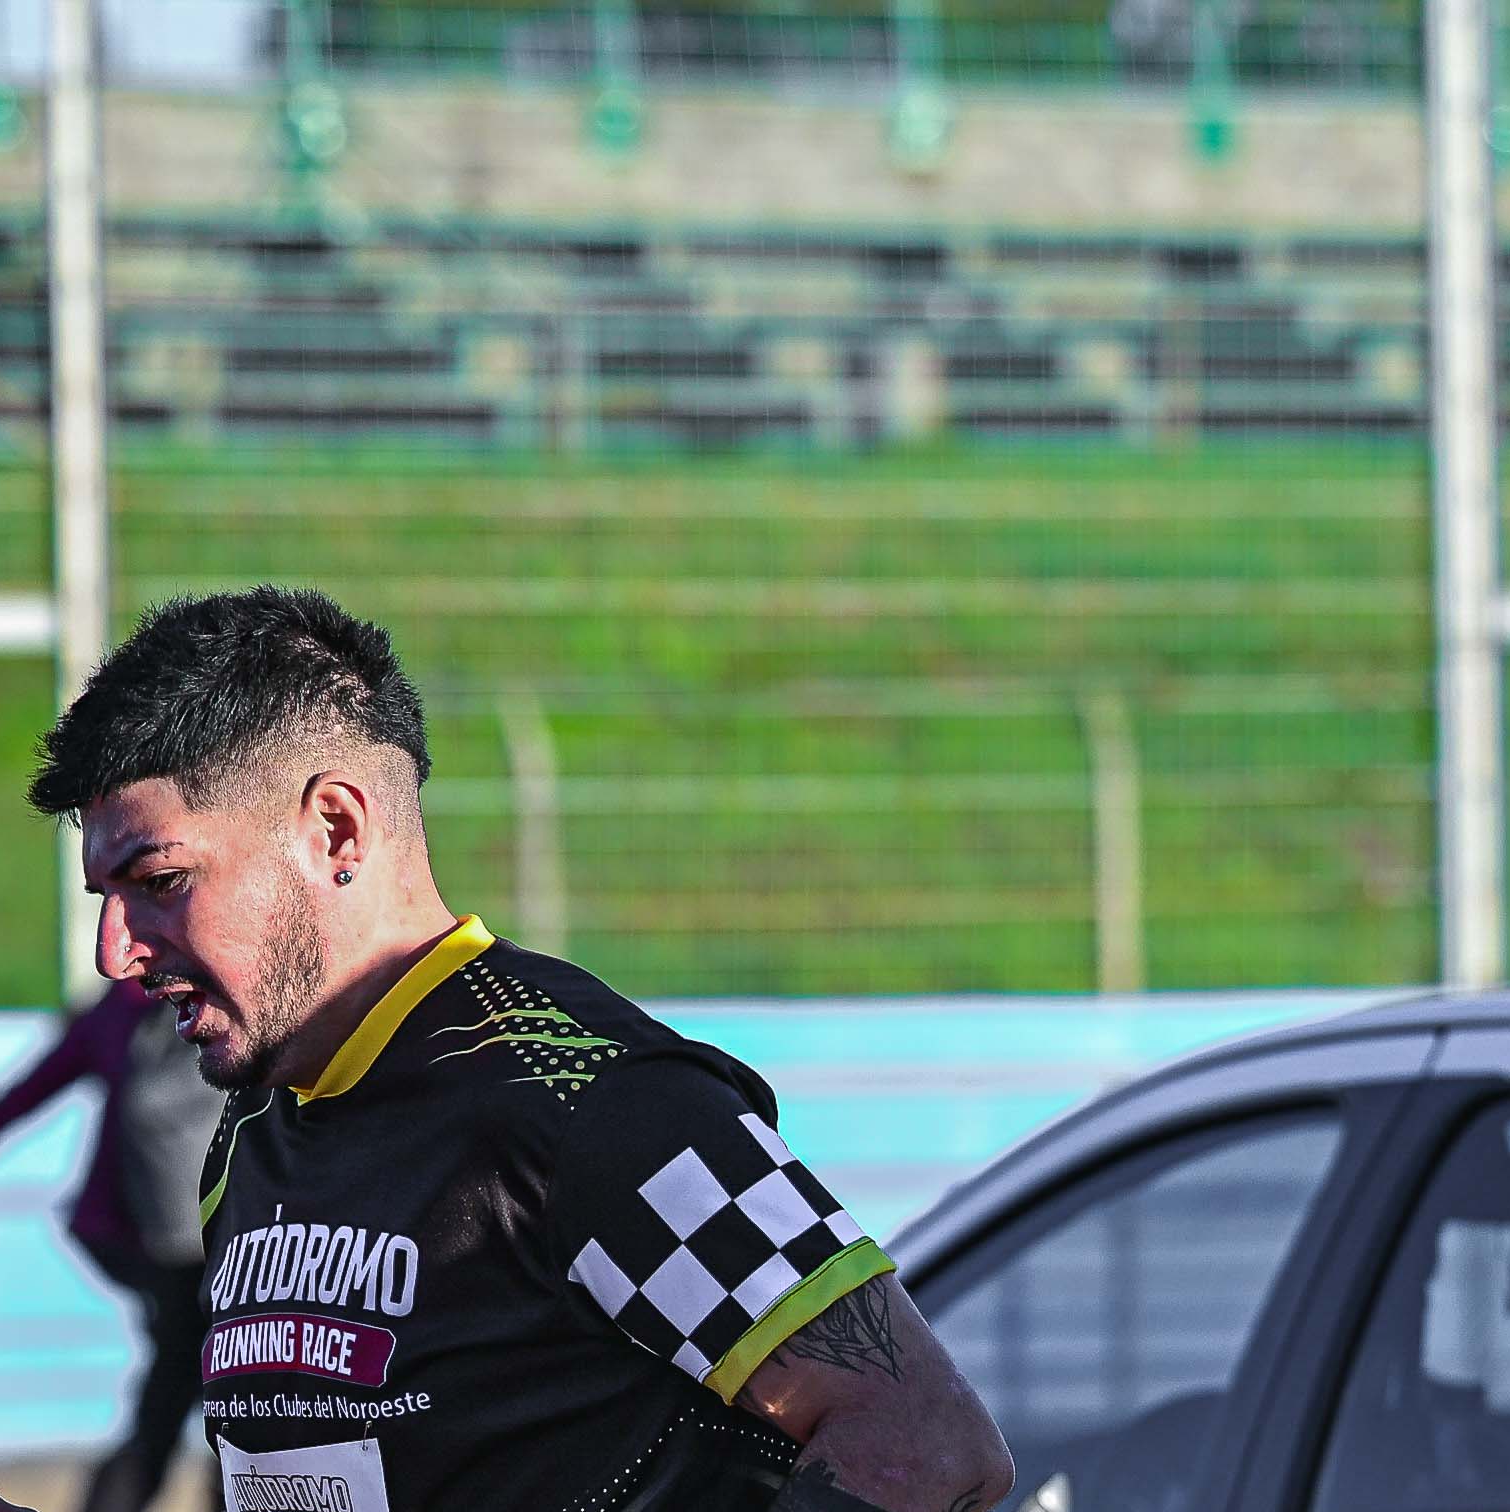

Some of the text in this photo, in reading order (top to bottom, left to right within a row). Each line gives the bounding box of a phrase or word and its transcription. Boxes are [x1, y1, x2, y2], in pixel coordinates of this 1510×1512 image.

[210, 1203, 419, 1317] AUTÓDROMO
[210, 1320, 358, 1376] RUNNING RACE
[229, 1394, 247, 1418] de
[250, 1393, 271, 1418] los
[273, 1393, 312, 1418] Clubes
[313, 1393, 333, 1419] del
[335, 1391, 431, 1419] Noroeste
